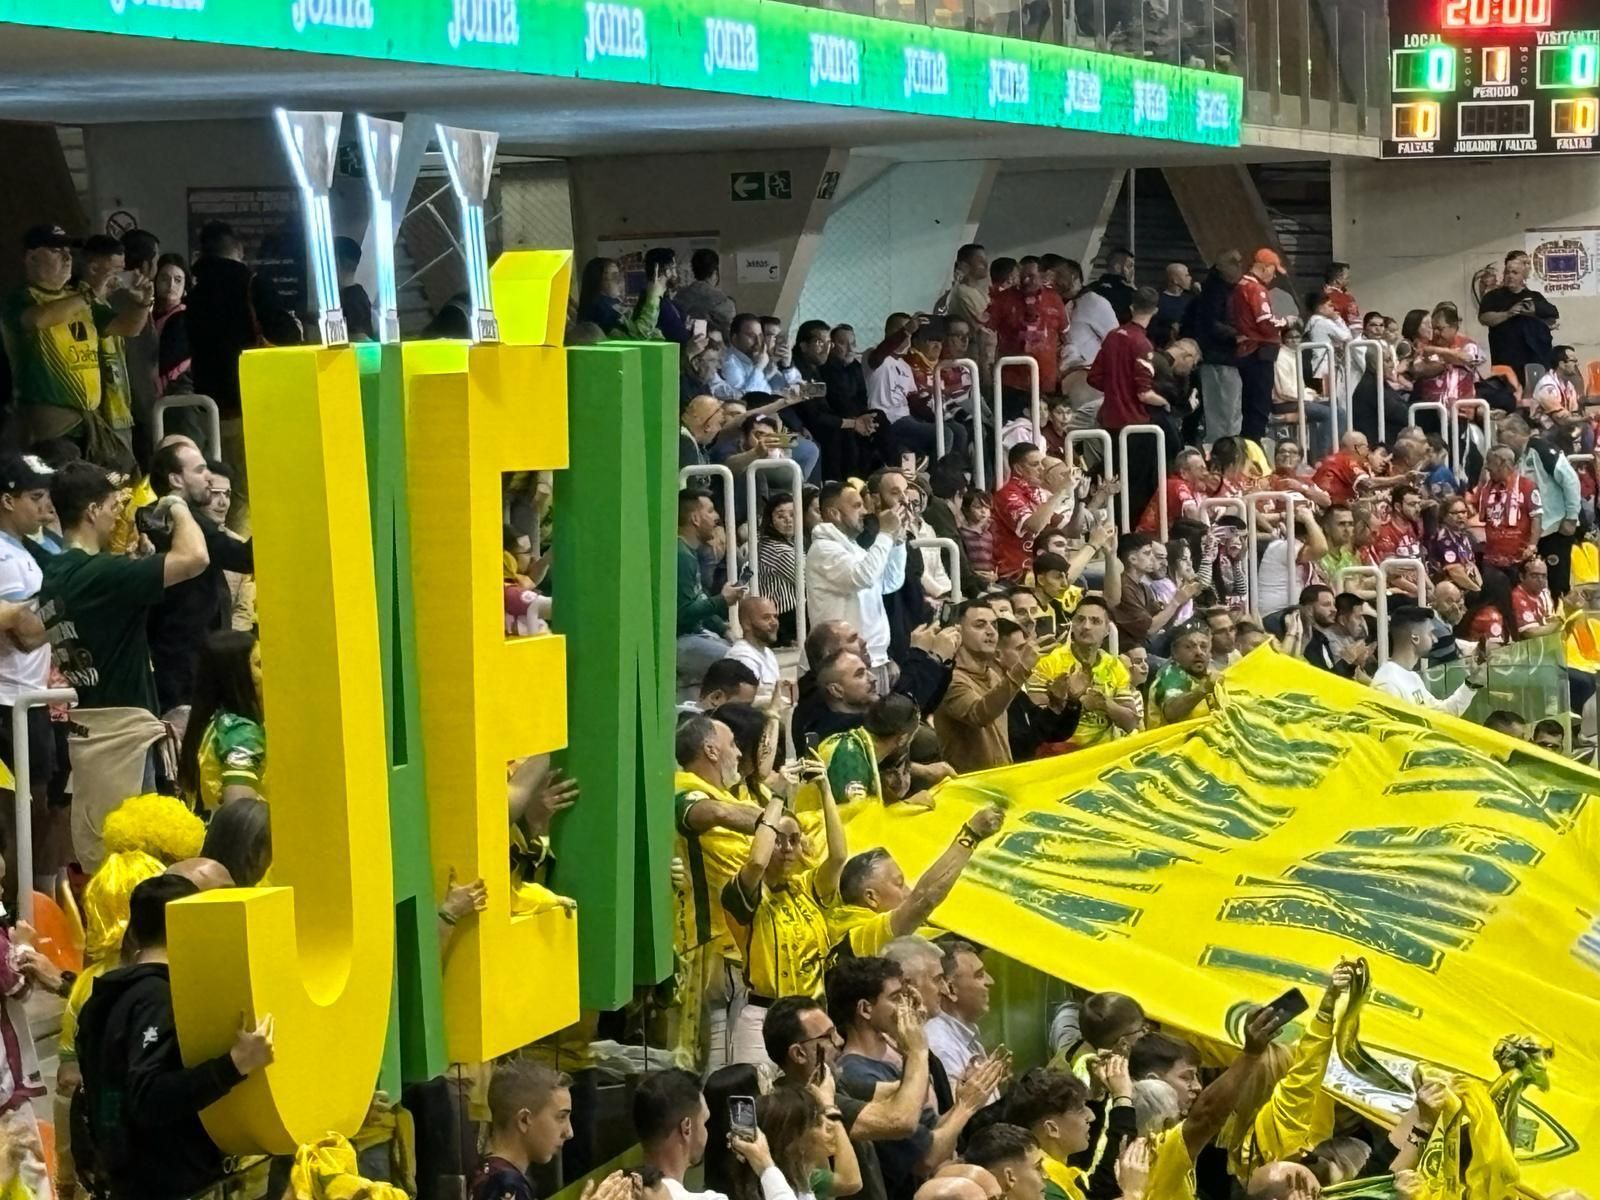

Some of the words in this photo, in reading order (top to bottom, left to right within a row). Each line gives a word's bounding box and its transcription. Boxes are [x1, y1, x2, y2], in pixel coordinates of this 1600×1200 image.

[1427, 48, 1453, 91] 0
[1572, 46, 1595, 86] 0
[1473, 86, 1519, 98] PERIODO
[1416, 103, 1436, 138] 0
[1574, 99, 1595, 134] 0
[1398, 142, 1434, 153] FALTAS
